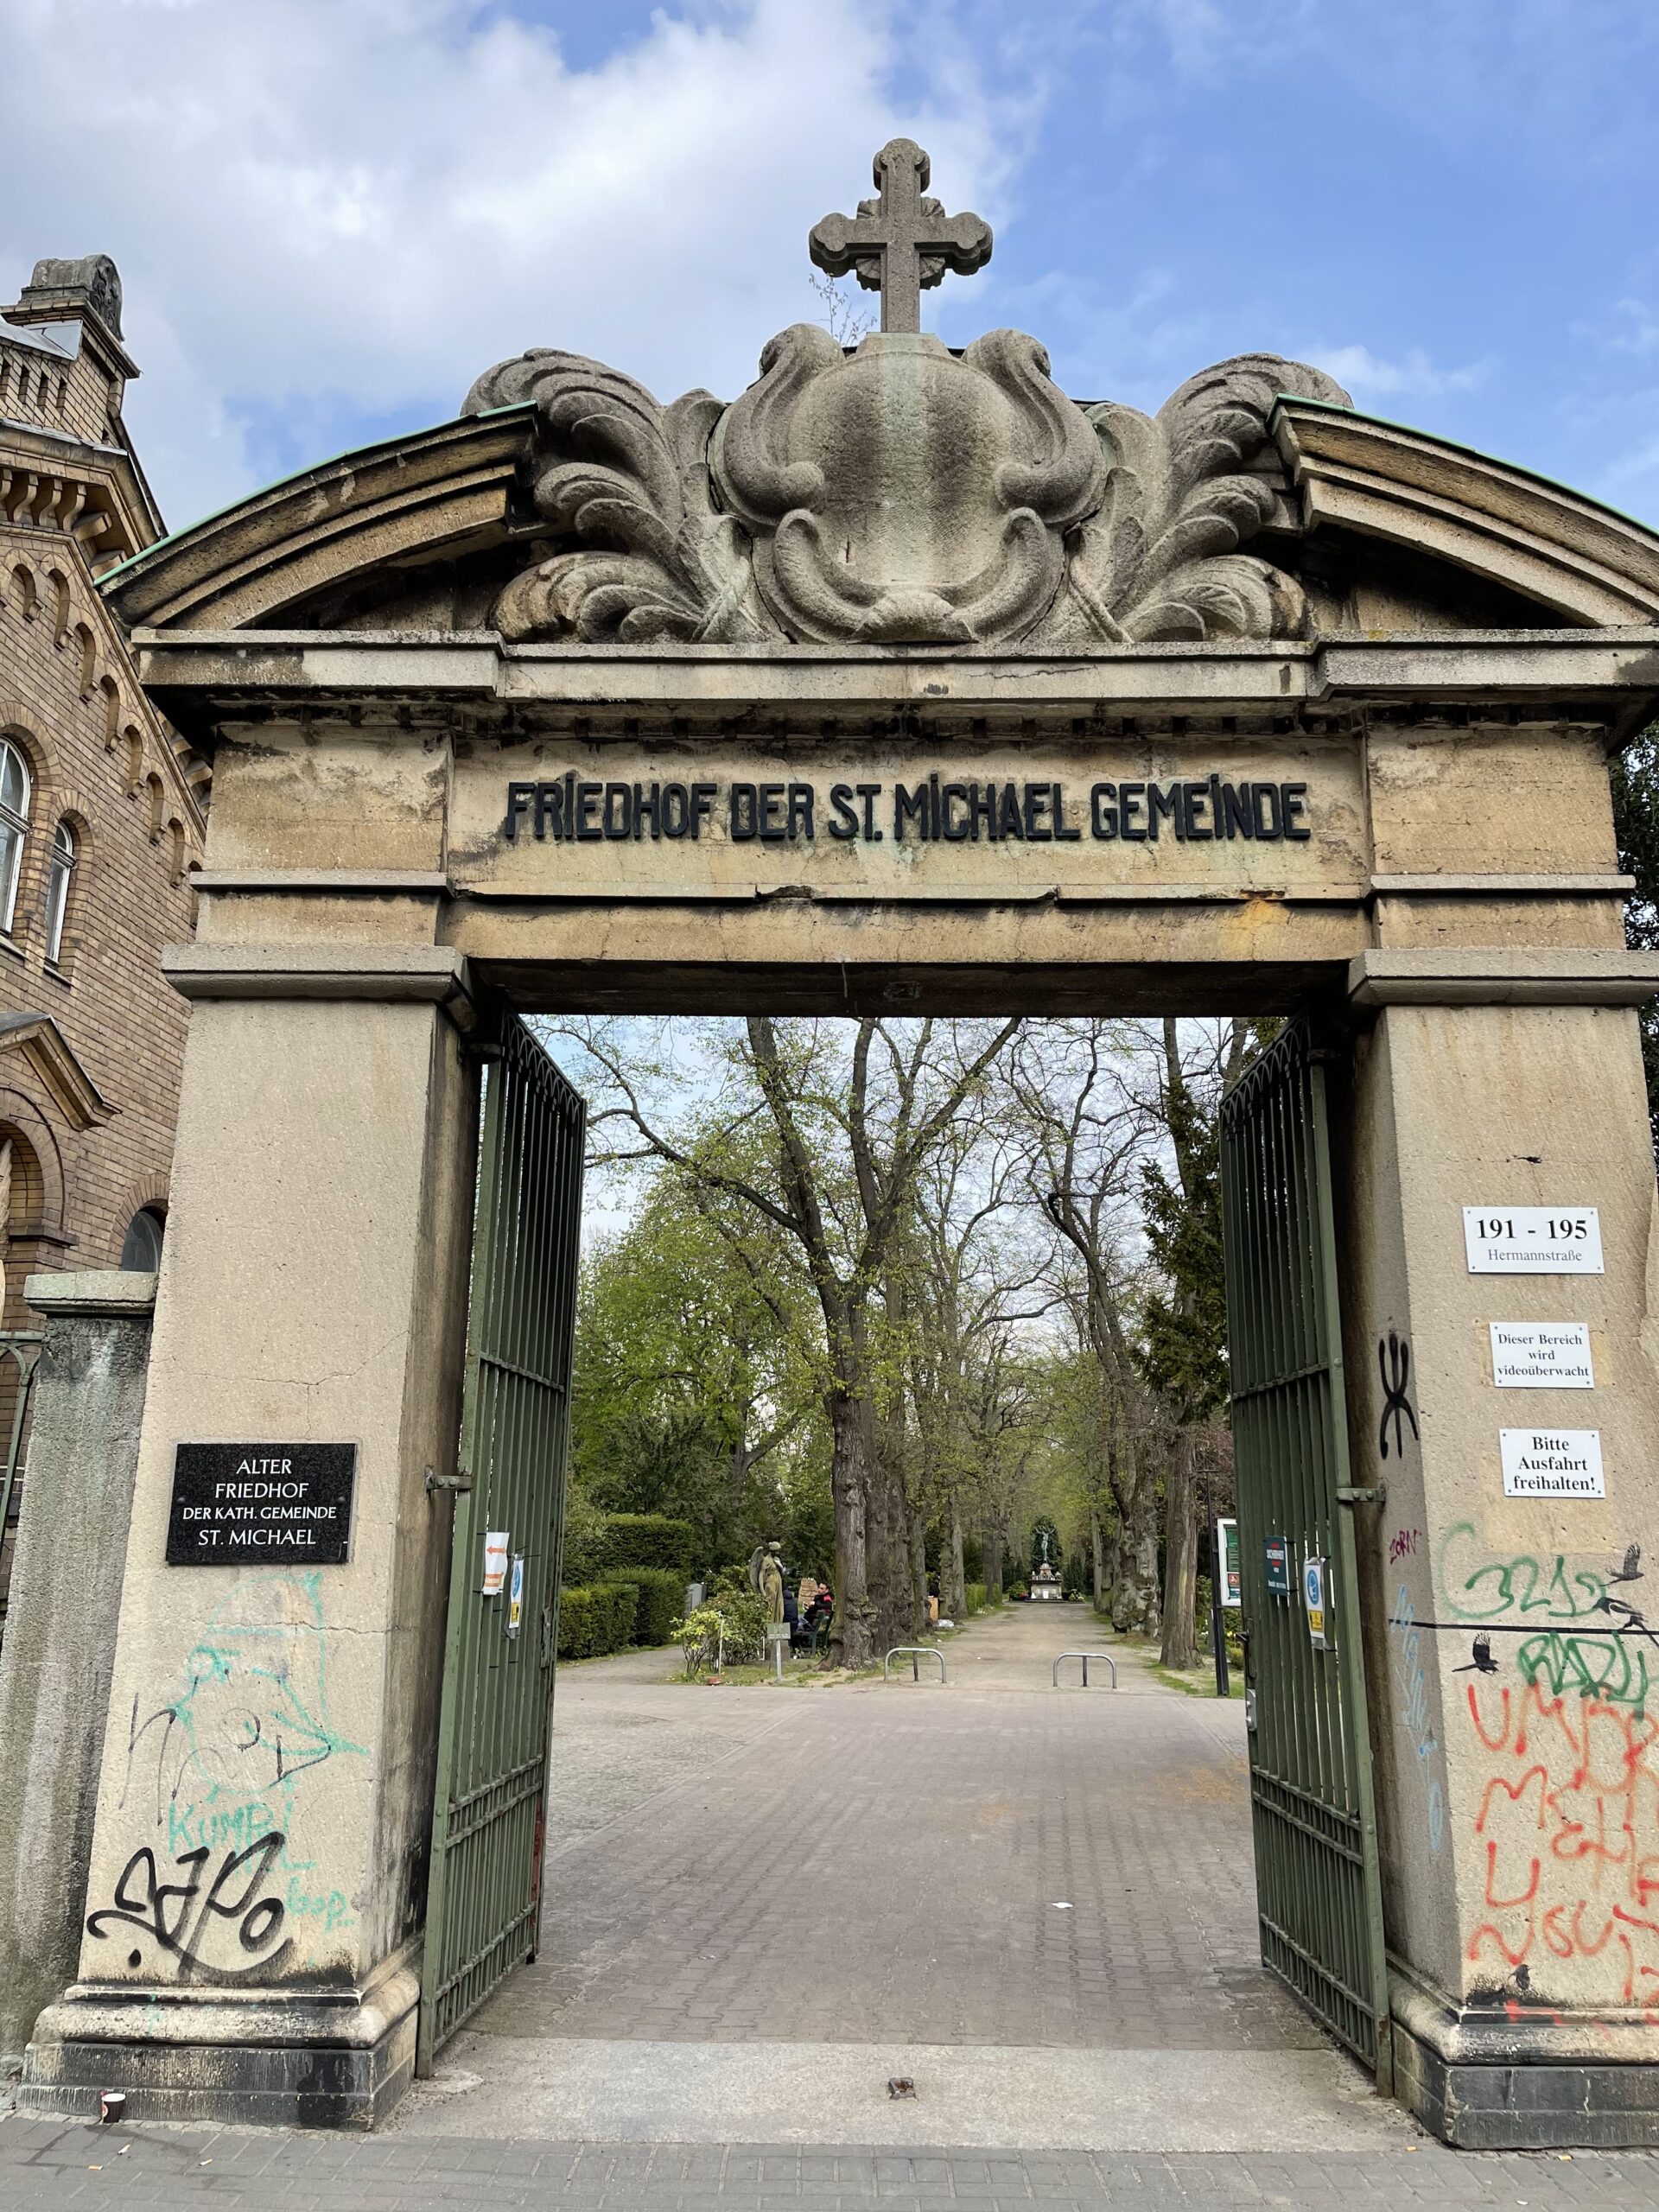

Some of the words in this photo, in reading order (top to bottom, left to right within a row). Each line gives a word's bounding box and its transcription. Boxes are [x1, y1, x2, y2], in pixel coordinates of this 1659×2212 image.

[505, 772, 717, 839] FRIEDHOF
[731, 783, 814, 841] DER
[830, 784, 883, 840] ST.
[1477, 1218, 1517, 1239] 191
[1547, 1219, 1587, 1240] 195
[1488, 1249, 1583, 1262] Hermannstraße
[1498, 1333, 1534, 1344] Dieser
[1539, 1333, 1582, 1345] Bereich
[1529, 1350, 1555, 1360] wird
[1497, 1365, 1589, 1376] videoüberwacht
[1532, 1436, 1570, 1451] Bitte
[236, 1459, 292, 1474] ALTER
[1518, 1456, 1587, 1471] Ausfahrt
[215, 1483, 309, 1498] FRIEDHOF
[1513, 1475, 1595, 1491] freihalten!
[182, 1507, 212, 1520] DER
[215, 1507, 257, 1520] KATH.
[260, 1506, 337, 1519] GEMEINDE
[198, 1529, 224, 1546] ST.
[229, 1529, 316, 1545] MICHAEL
